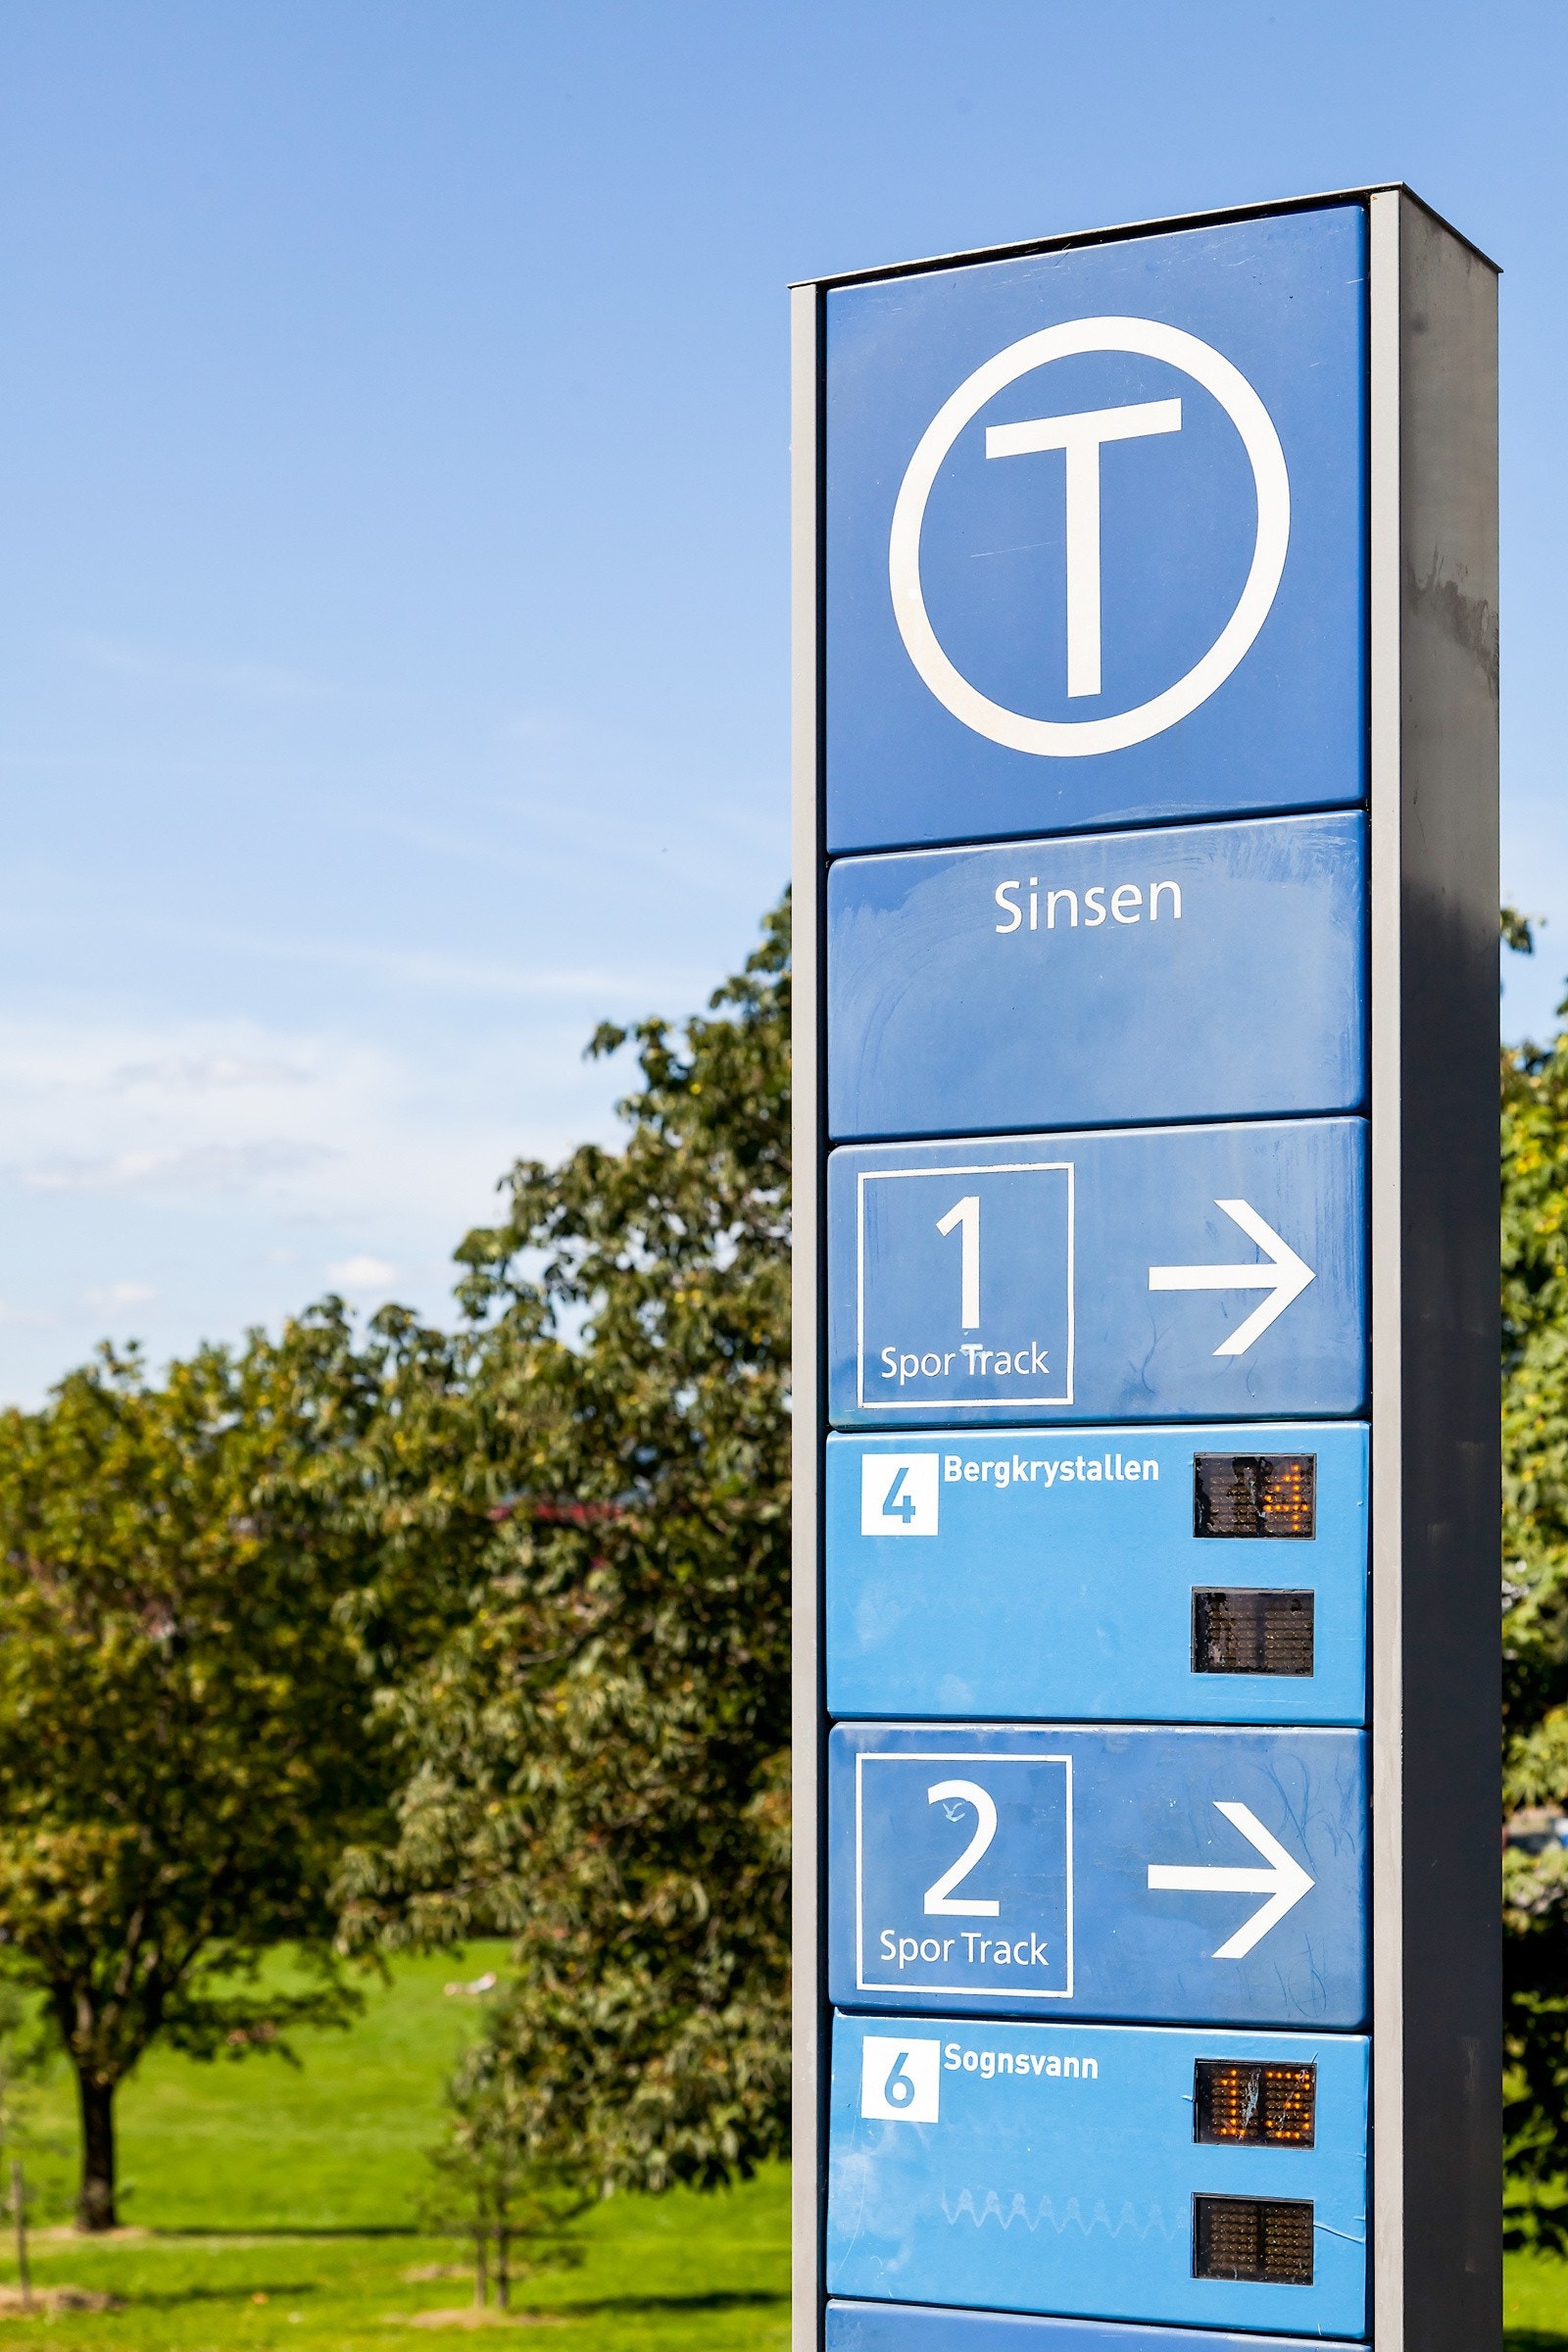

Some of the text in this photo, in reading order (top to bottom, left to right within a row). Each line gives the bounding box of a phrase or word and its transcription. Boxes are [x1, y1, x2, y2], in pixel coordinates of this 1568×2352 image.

[985, 398, 1182, 698] T
[994, 877, 1183, 936] Sinsen
[935, 1196, 980, 1329] 1
[880, 1341, 1050, 1386] Spor Track
[881, 1467, 916, 1524] 4
[944, 1454, 1159, 1489] Bergkrystallen
[1263, 1464, 1309, 1531] 4
[923, 1780, 1000, 1917] 2
[880, 1930, 1049, 1969] Spor Track
[883, 2052, 915, 2108] 6
[944, 2043, 1099, 2082] Sognsvann
[1220, 2069, 1310, 2138] 13
